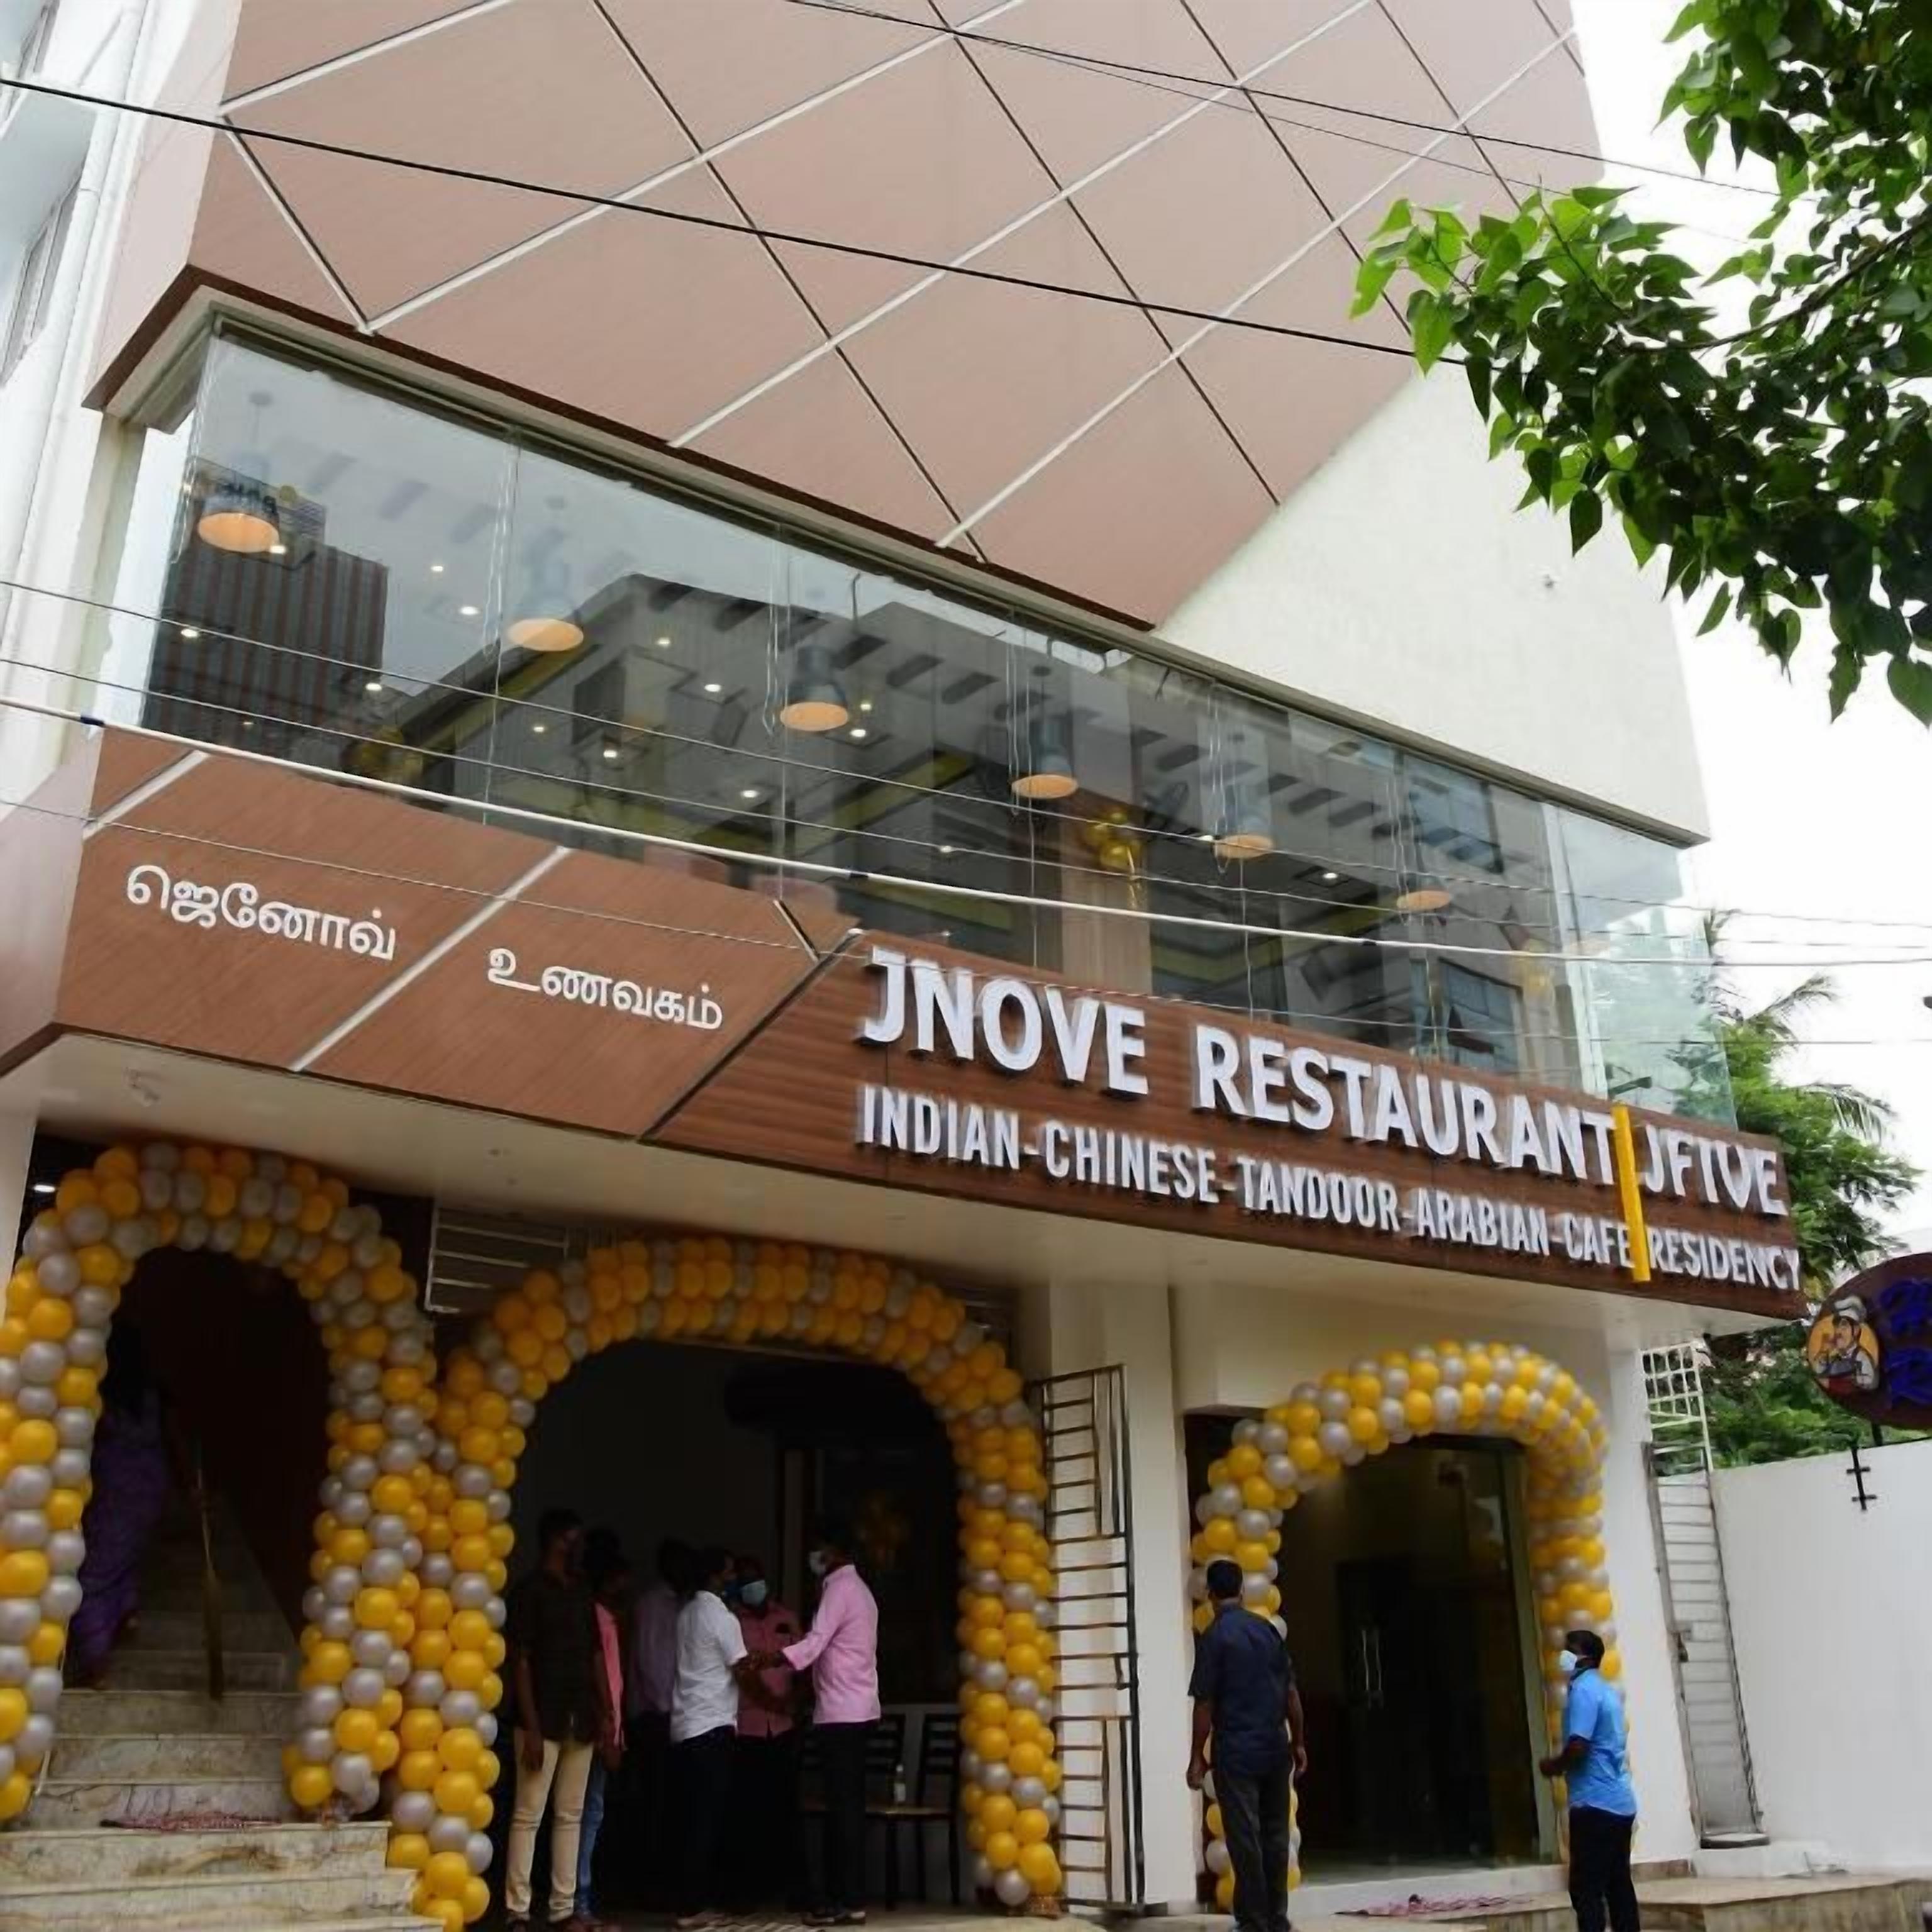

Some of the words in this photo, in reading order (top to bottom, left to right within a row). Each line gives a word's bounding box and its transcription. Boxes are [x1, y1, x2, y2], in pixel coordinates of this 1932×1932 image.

[487, 948, 723, 1030] உணவகம்
[858, 945, 1149, 1096] JNOVE
[1196, 1024, 1615, 1185] RESTAURANT
[1646, 1226, 1801, 1291] RESIDENCY
